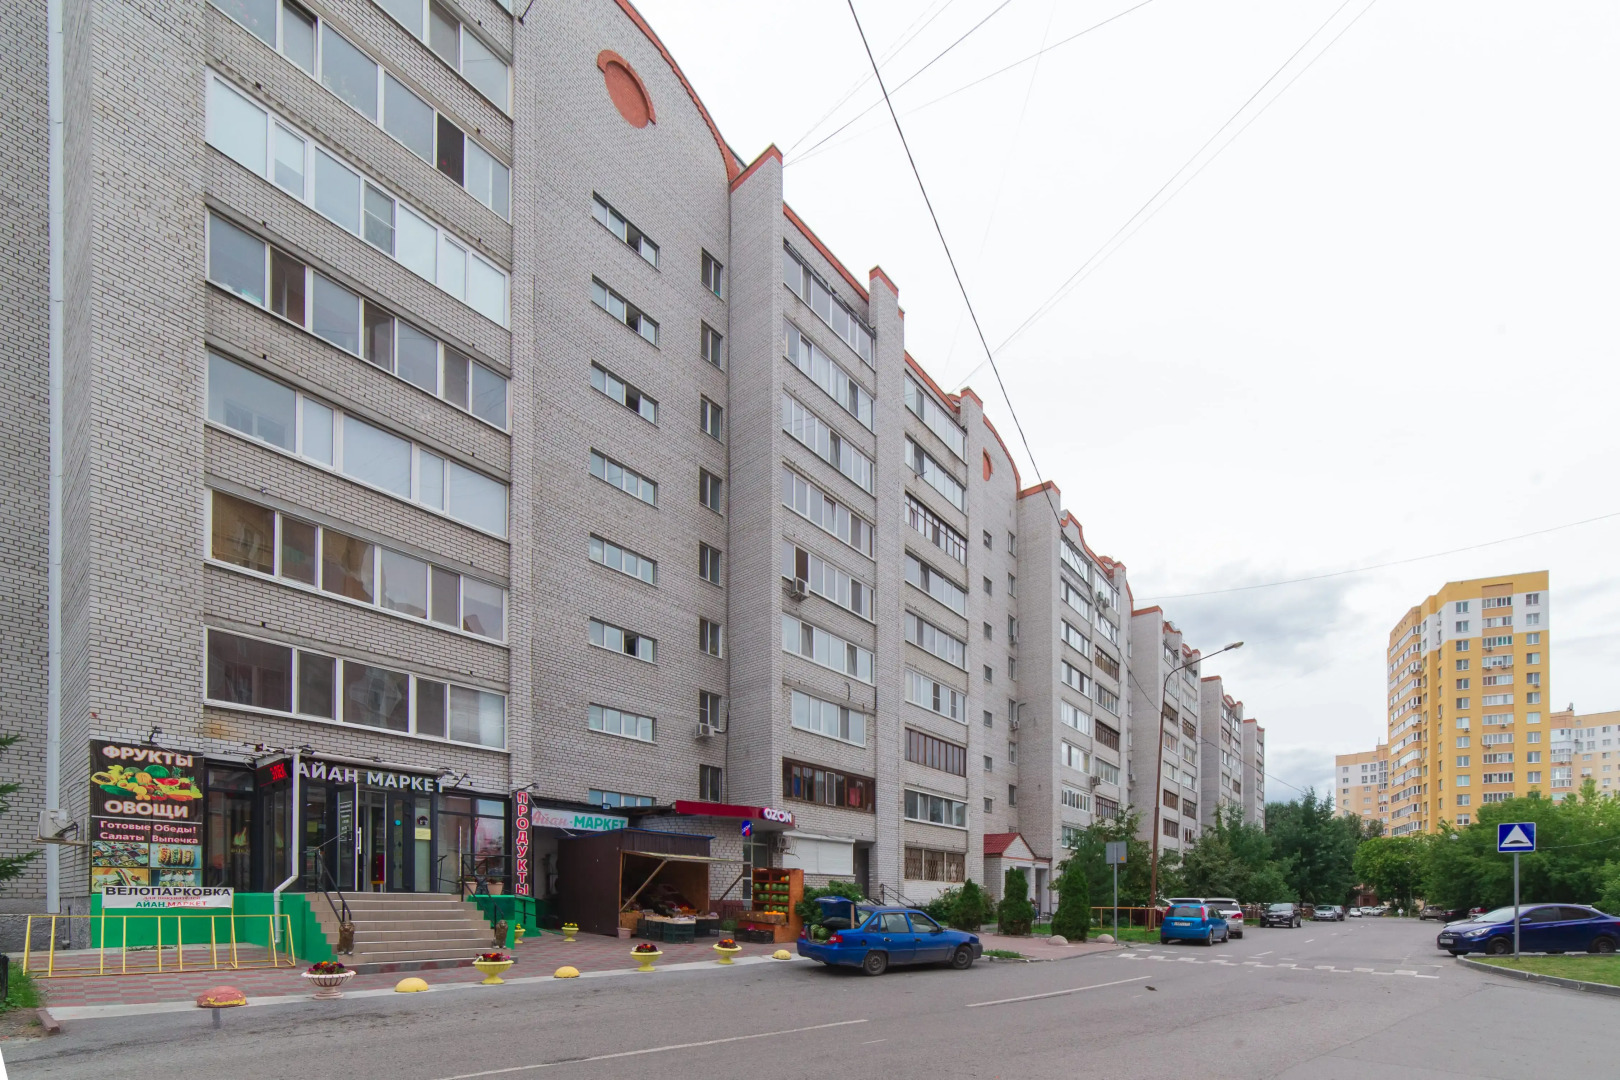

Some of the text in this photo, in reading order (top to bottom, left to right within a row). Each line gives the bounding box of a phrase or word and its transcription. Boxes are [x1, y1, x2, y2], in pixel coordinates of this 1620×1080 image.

[102, 745, 194, 767] ФРУКТЫ
[299, 761, 444, 793] АЙАН МАРКЕТ
[104, 800, 189, 819] ОВОЩИ
[763, 807, 793, 823] OZON
[100, 820, 197, 834] Готовые Обеды!
[573, 815, 626, 831] МАРКЕТ
[99, 832, 199, 844] Салаты Выпечка
[516, 791, 529, 895] ПРОДУКТЫ
[105, 886, 231, 897] ВЕЛОПАРКОВКА
